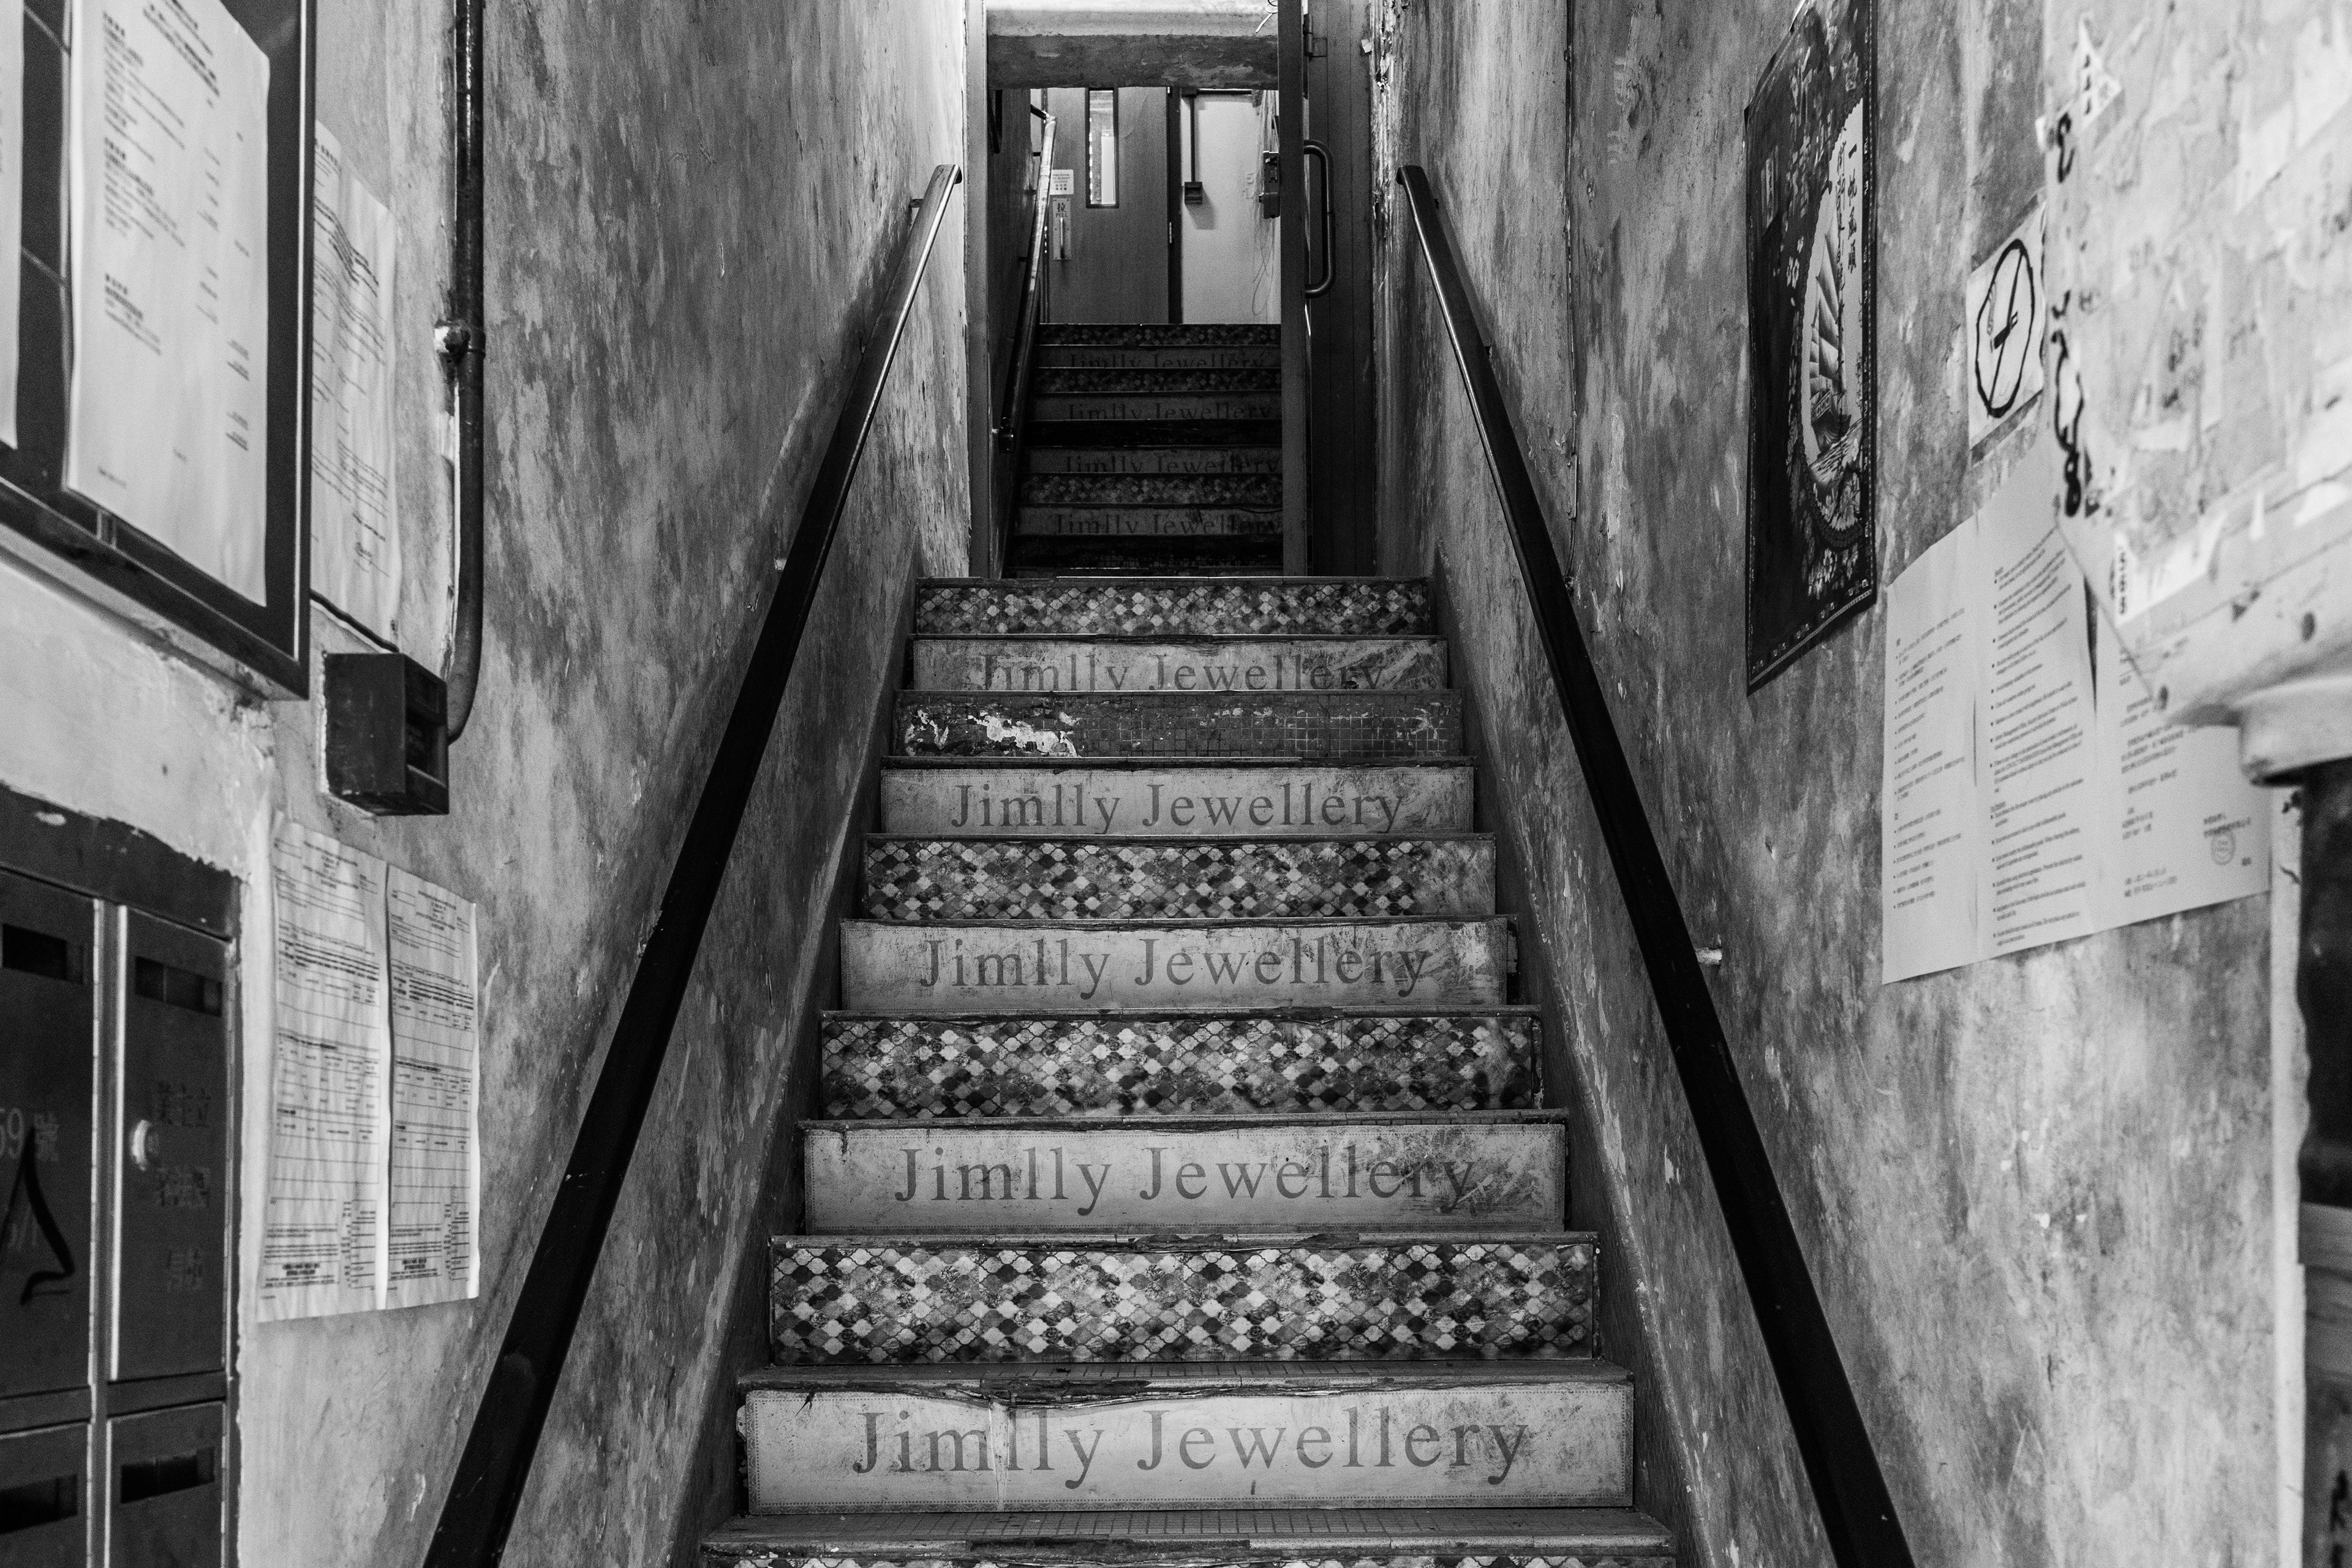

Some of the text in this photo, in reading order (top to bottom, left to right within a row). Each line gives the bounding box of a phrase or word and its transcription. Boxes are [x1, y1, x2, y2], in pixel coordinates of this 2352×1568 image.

[1847, 143, 1858, 274] 一帆風順
[951, 784, 1404, 834] Jimlly Jewellery
[921, 938, 1429, 1000] Jimlly Jewellery
[895, 1147, 1473, 1215] Jimlly Jewellery
[851, 1407, 1529, 1489] Jimlly Jewellery
